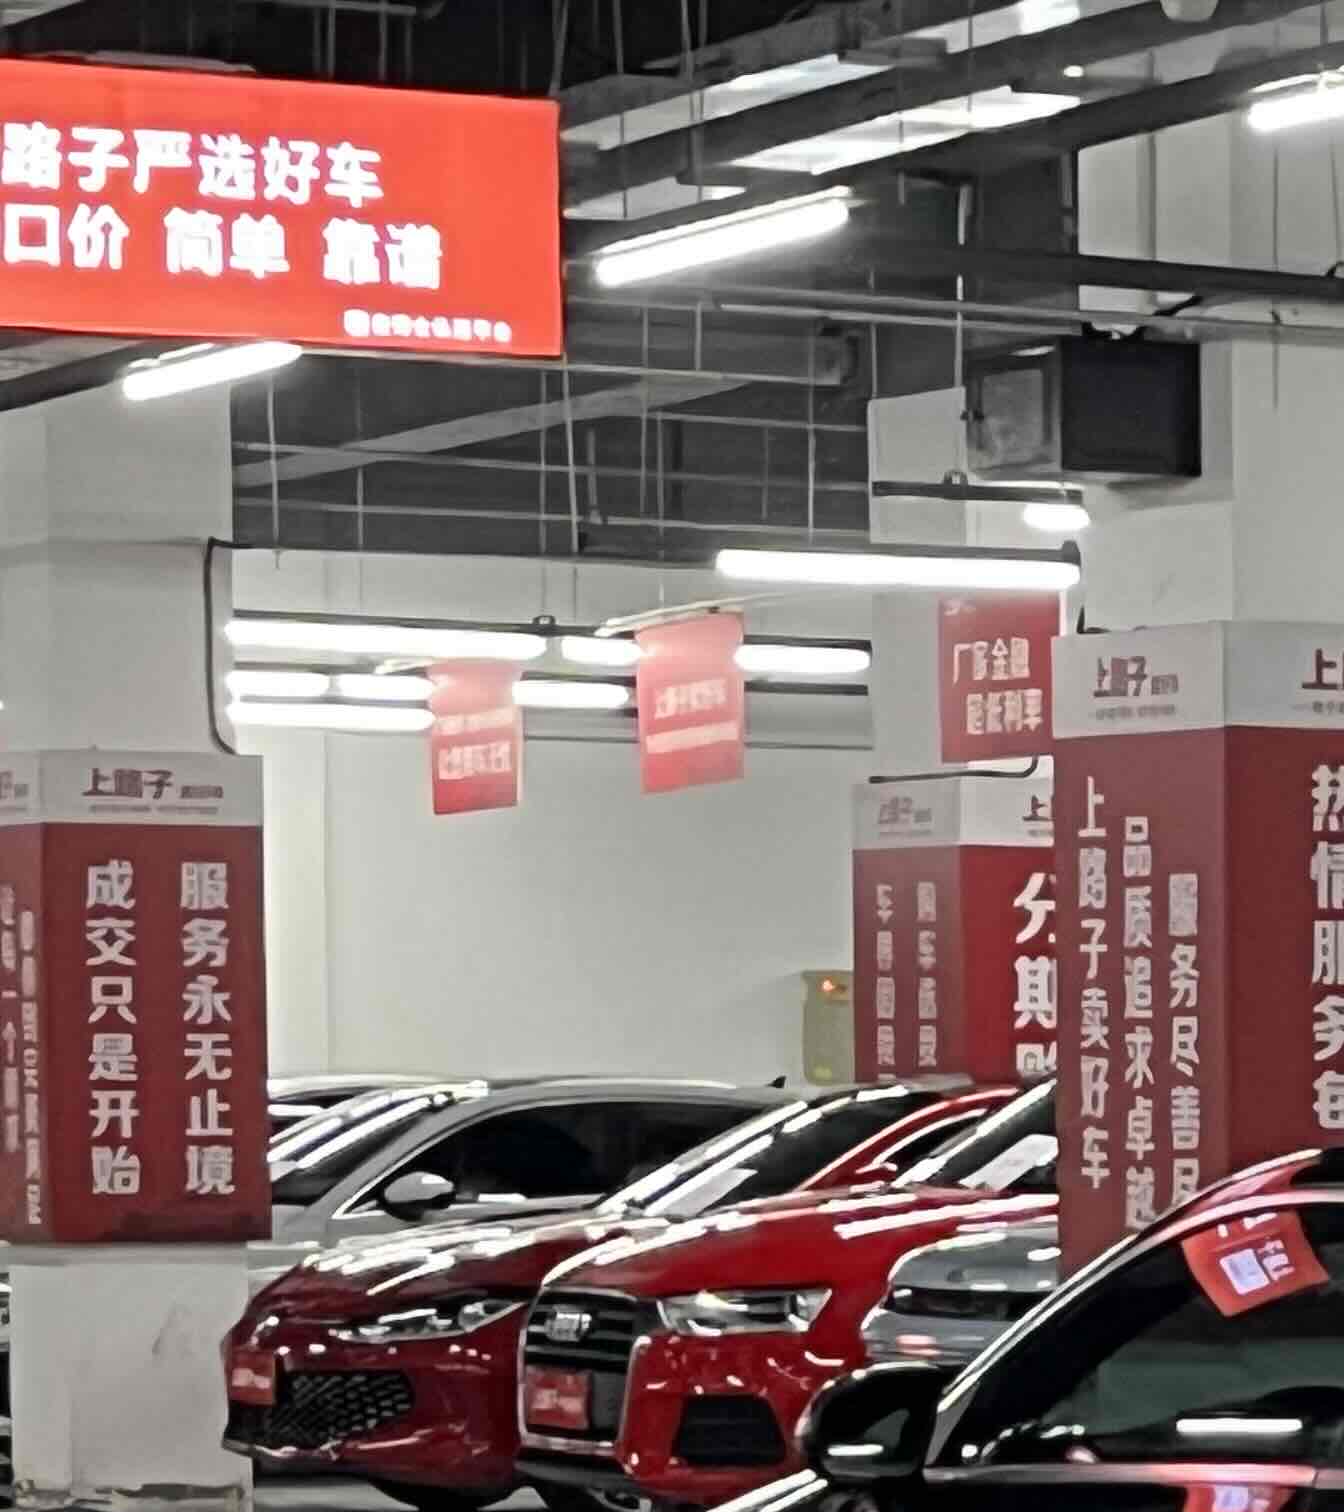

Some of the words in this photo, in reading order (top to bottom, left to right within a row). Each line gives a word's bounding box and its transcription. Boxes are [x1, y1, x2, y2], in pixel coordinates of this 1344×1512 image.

[2, 121, 384, 208] 路子严选好车
[3, 203, 130, 271] 口价
[163, 207, 290, 279] 简单
[322, 217, 443, 290] 靠谱
[85, 859, 141, 1196] 成交只是开始
[179, 861, 236, 1196] 服务永无止境
